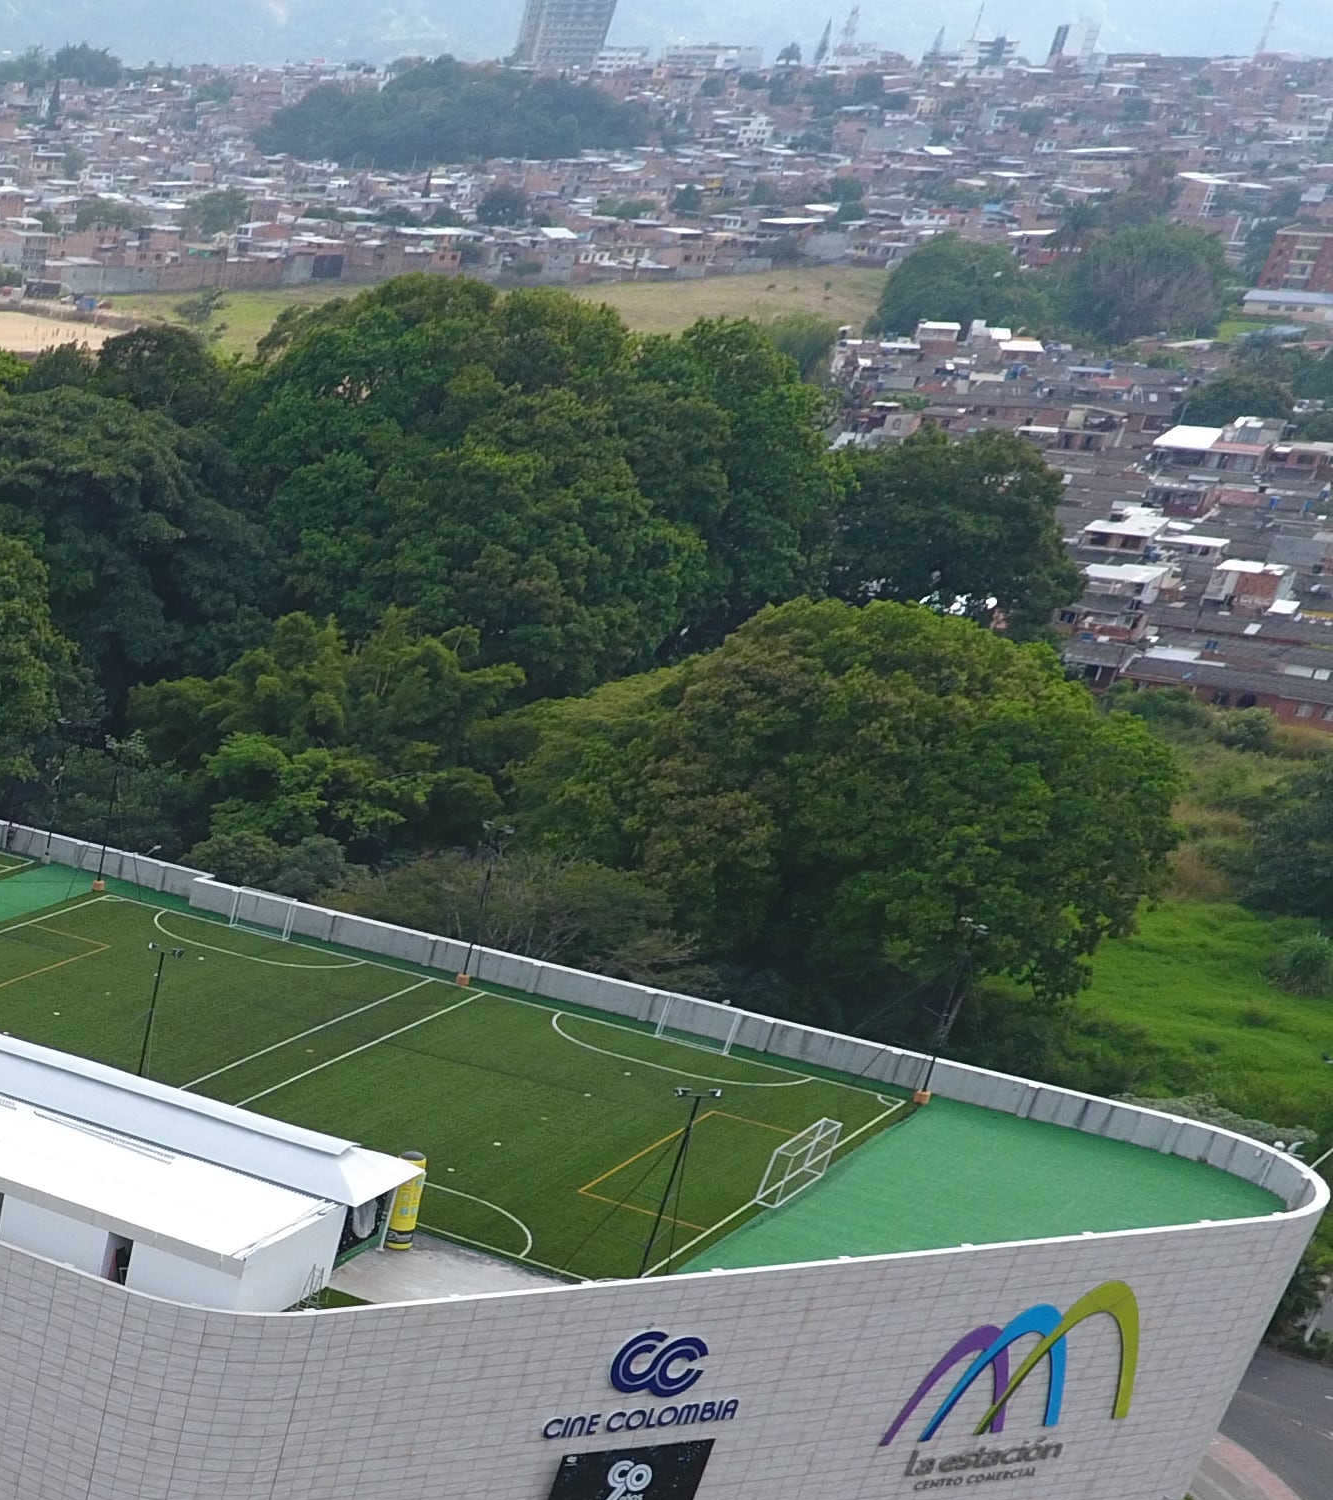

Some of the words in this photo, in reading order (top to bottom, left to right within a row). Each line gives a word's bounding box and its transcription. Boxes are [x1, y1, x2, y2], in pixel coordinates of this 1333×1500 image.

[543, 1413, 601, 1439] CINE
[606, 1399, 740, 1432] COLOMBIA
[938, 1436, 1064, 1473] estación
[914, 1476, 963, 1490] CENTRO
[966, 1467, 1036, 1485] COMERCIAL
